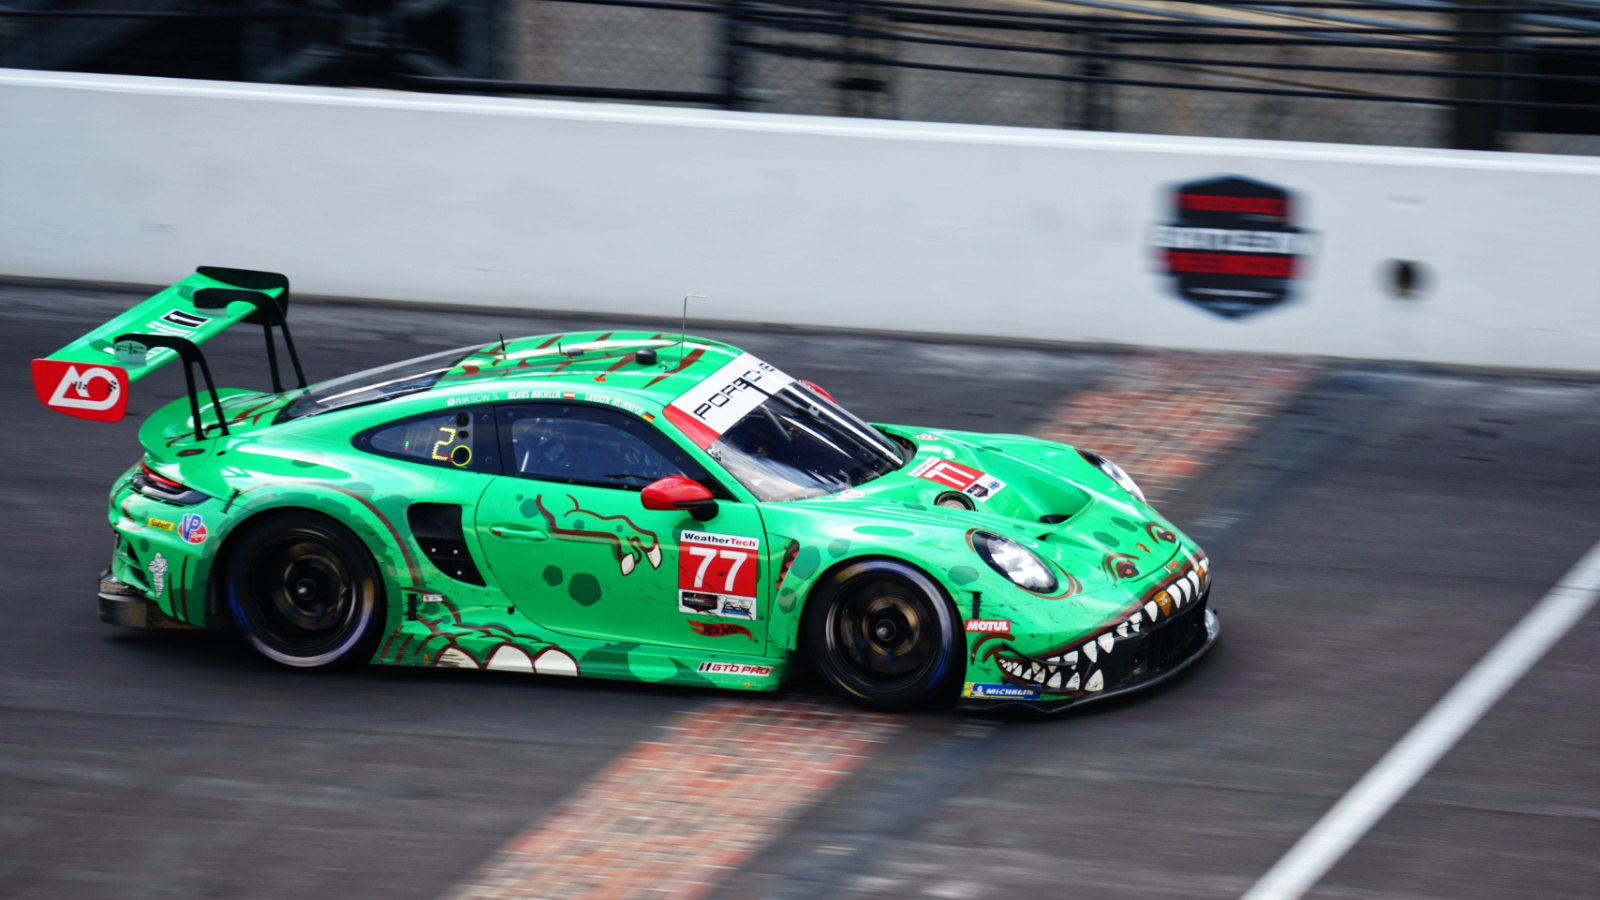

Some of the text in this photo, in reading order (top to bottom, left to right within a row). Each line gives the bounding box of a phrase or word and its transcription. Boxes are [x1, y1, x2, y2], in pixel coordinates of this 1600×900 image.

[431, 426, 457, 461] 2
[923, 462, 976, 487] 77
[183, 513, 202, 542] VP
[684, 533, 757, 547] WeatherTech
[689, 546, 748, 592] 77
[966, 621, 1009, 631] MOTUL
[711, 664, 770, 675] GTD PRO
[985, 687, 1034, 696] MICHELIN
